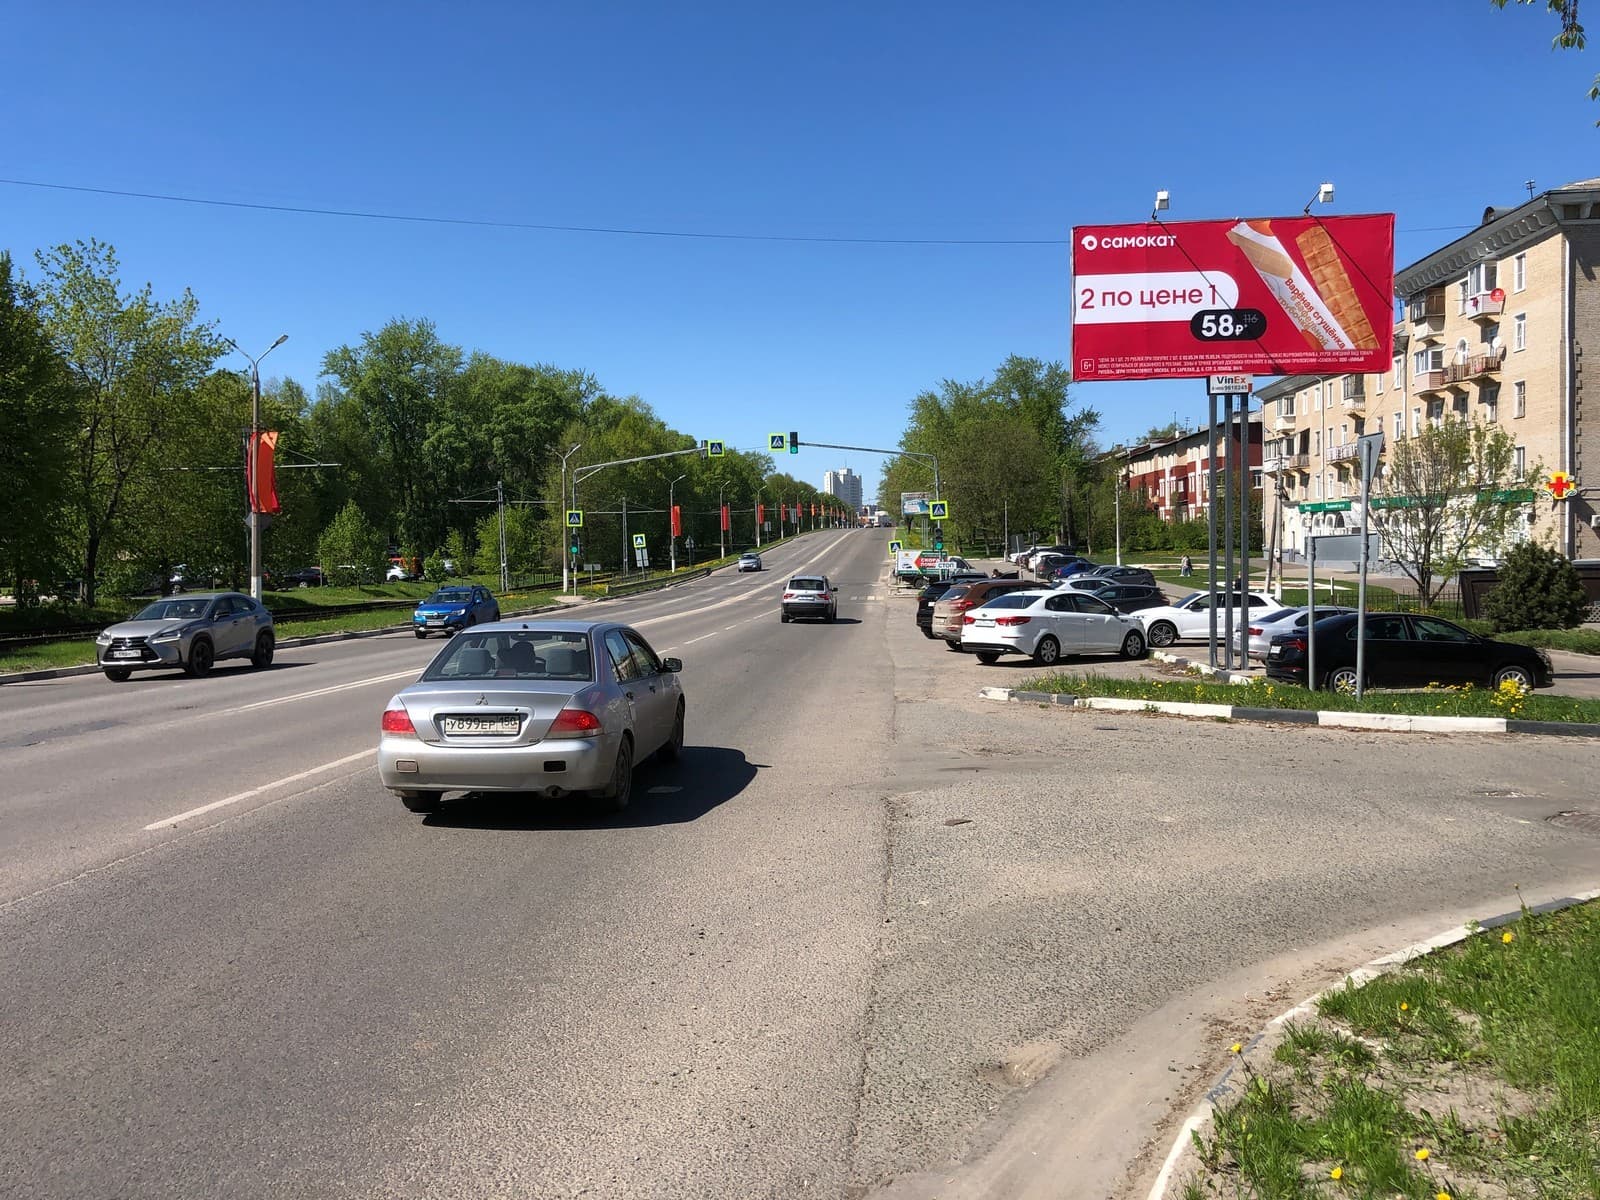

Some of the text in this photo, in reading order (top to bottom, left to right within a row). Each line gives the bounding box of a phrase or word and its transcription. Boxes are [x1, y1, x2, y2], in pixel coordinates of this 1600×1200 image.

[1101, 235, 1176, 249] самокат
[1081, 284, 1216, 309] 2 по цене 1
[1284, 278, 1346, 350] Варёная сгущёнка
[1217, 376, 1246, 384] VinEx
